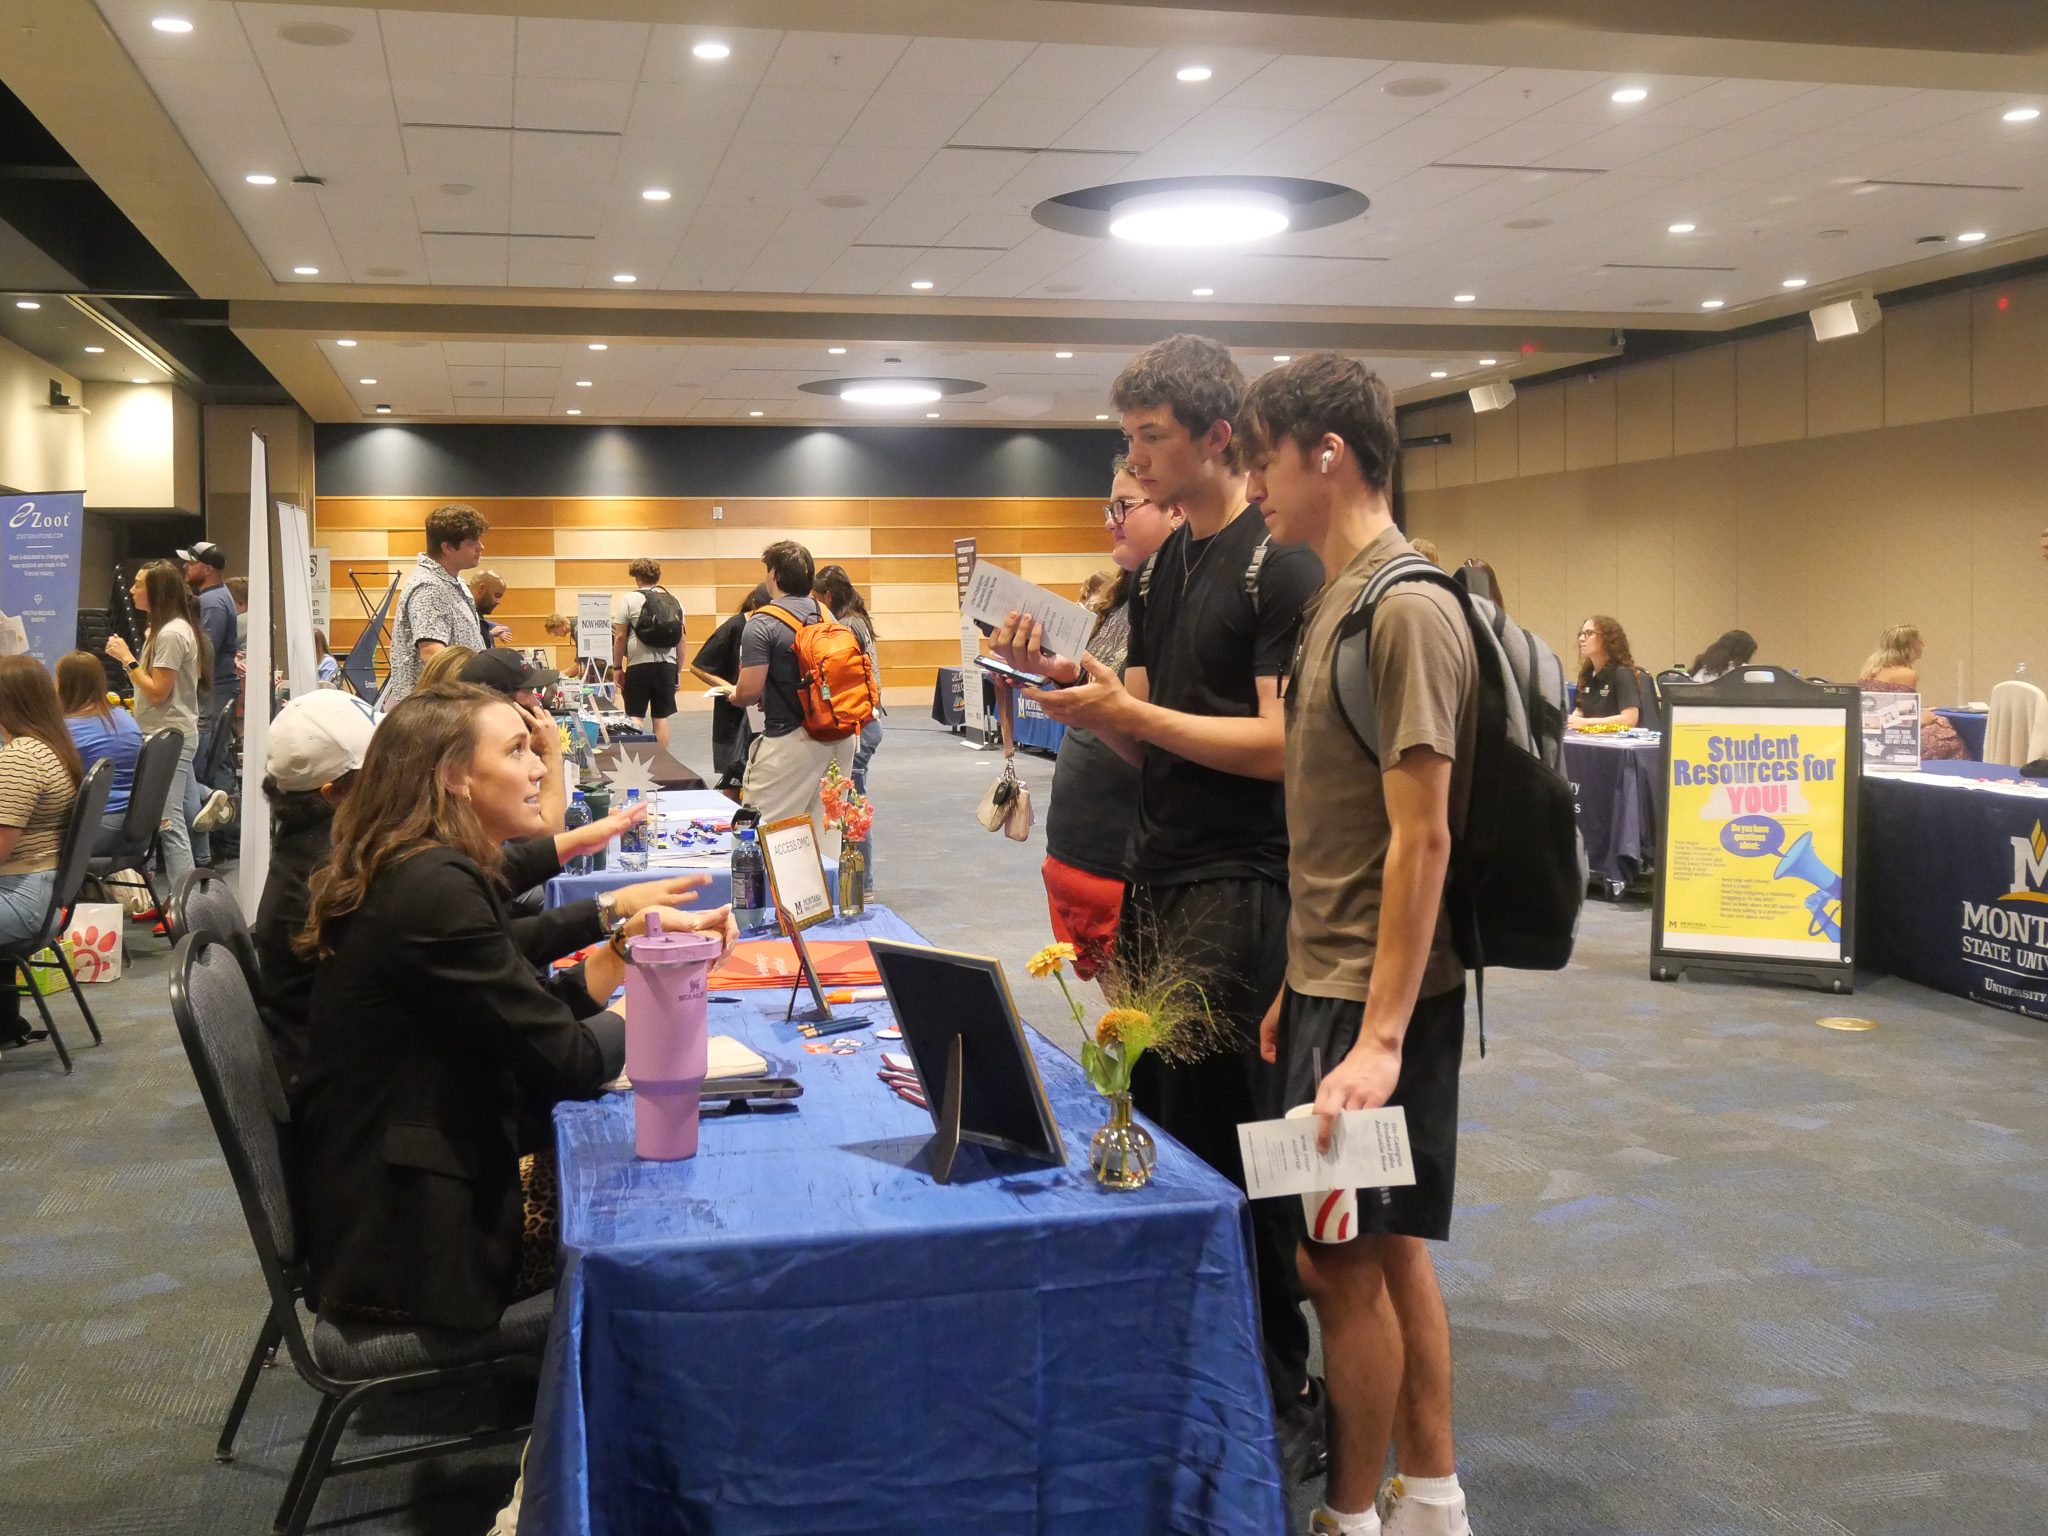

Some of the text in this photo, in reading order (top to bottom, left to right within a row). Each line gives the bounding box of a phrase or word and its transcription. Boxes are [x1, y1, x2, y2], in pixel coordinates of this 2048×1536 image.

[31, 512, 69, 527] Zoot
[582, 620, 610, 628] NOW HIRING
[1708, 734, 1800, 762] Student
[1674, 754, 1836, 786] Resources for
[1726, 785, 1788, 814] YOU!
[775, 836, 810, 854] ACCESS DMC
[795, 902, 803, 914] M
[803, 894, 821, 906] MONTANA
[1962, 936, 2010, 962] STATE
[1374, 1119, 1389, 1173] Available Now
[1382, 1122, 1393, 1152] Student
[1390, 1122, 1404, 1167] On-Campus
